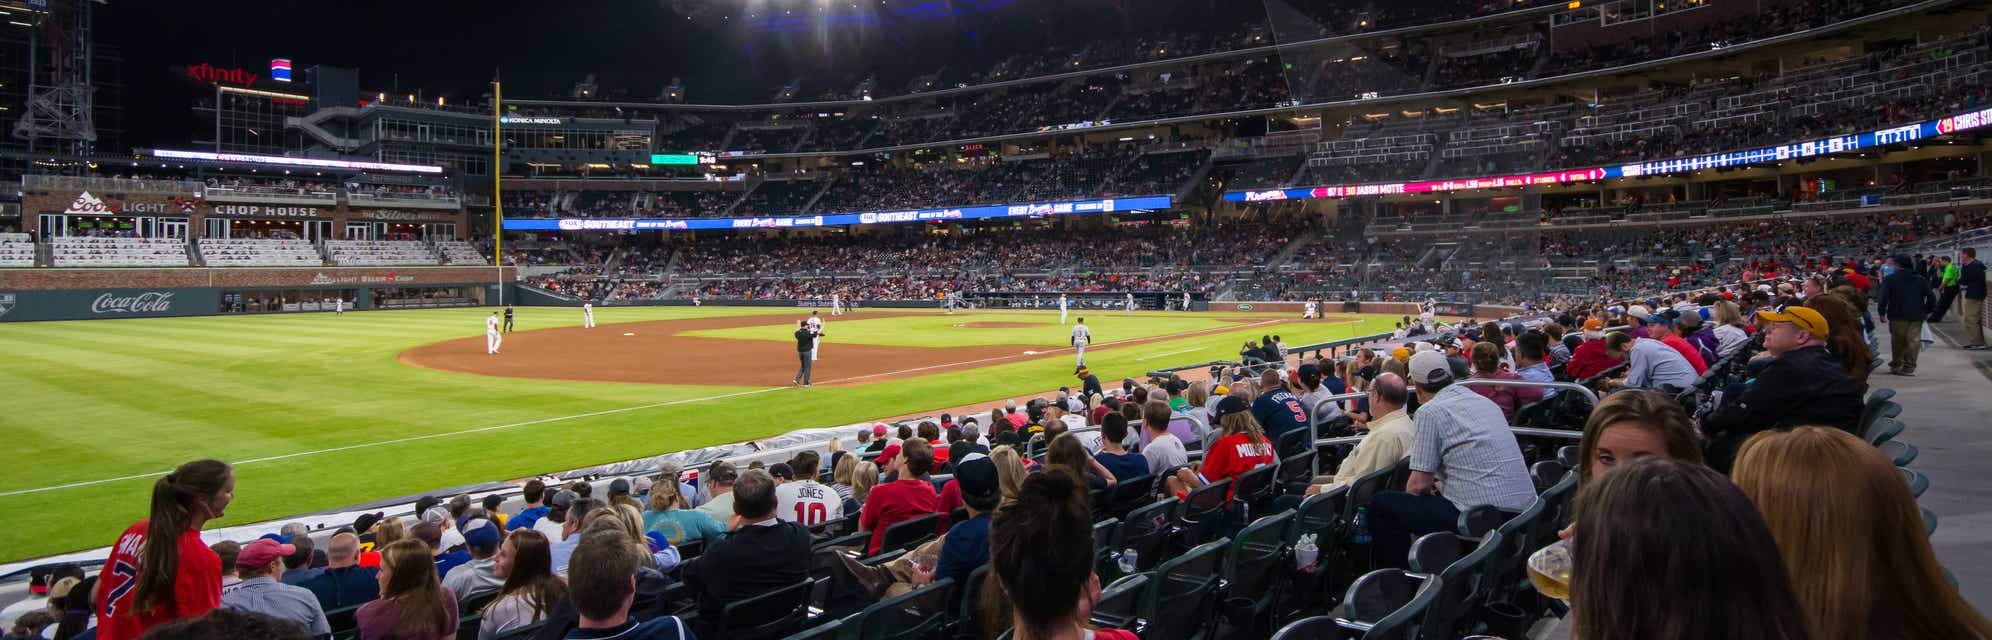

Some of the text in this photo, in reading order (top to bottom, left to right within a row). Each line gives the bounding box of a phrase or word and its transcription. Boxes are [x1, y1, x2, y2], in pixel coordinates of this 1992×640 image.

[185, 62, 258, 89] xfinity
[1942, 118, 1953, 132] 19
[1953, 112, 1980, 130] CHRIS
[1357, 185, 1379, 195] JASON
[1380, 184, 1404, 194] MOTTE
[122, 202, 168, 213] LIGHT
[215, 205, 318, 217] CHOP HOUSE
[583, 220, 635, 229] SOUTHEAST
[878, 211, 918, 222] SOUTHEAST
[91, 292, 175, 313] Coca-Cola
[1286, 400, 1307, 422] 5
[798, 487, 824, 499] JONES
[794, 501, 827, 526] 10
[105, 560, 137, 617] 7
